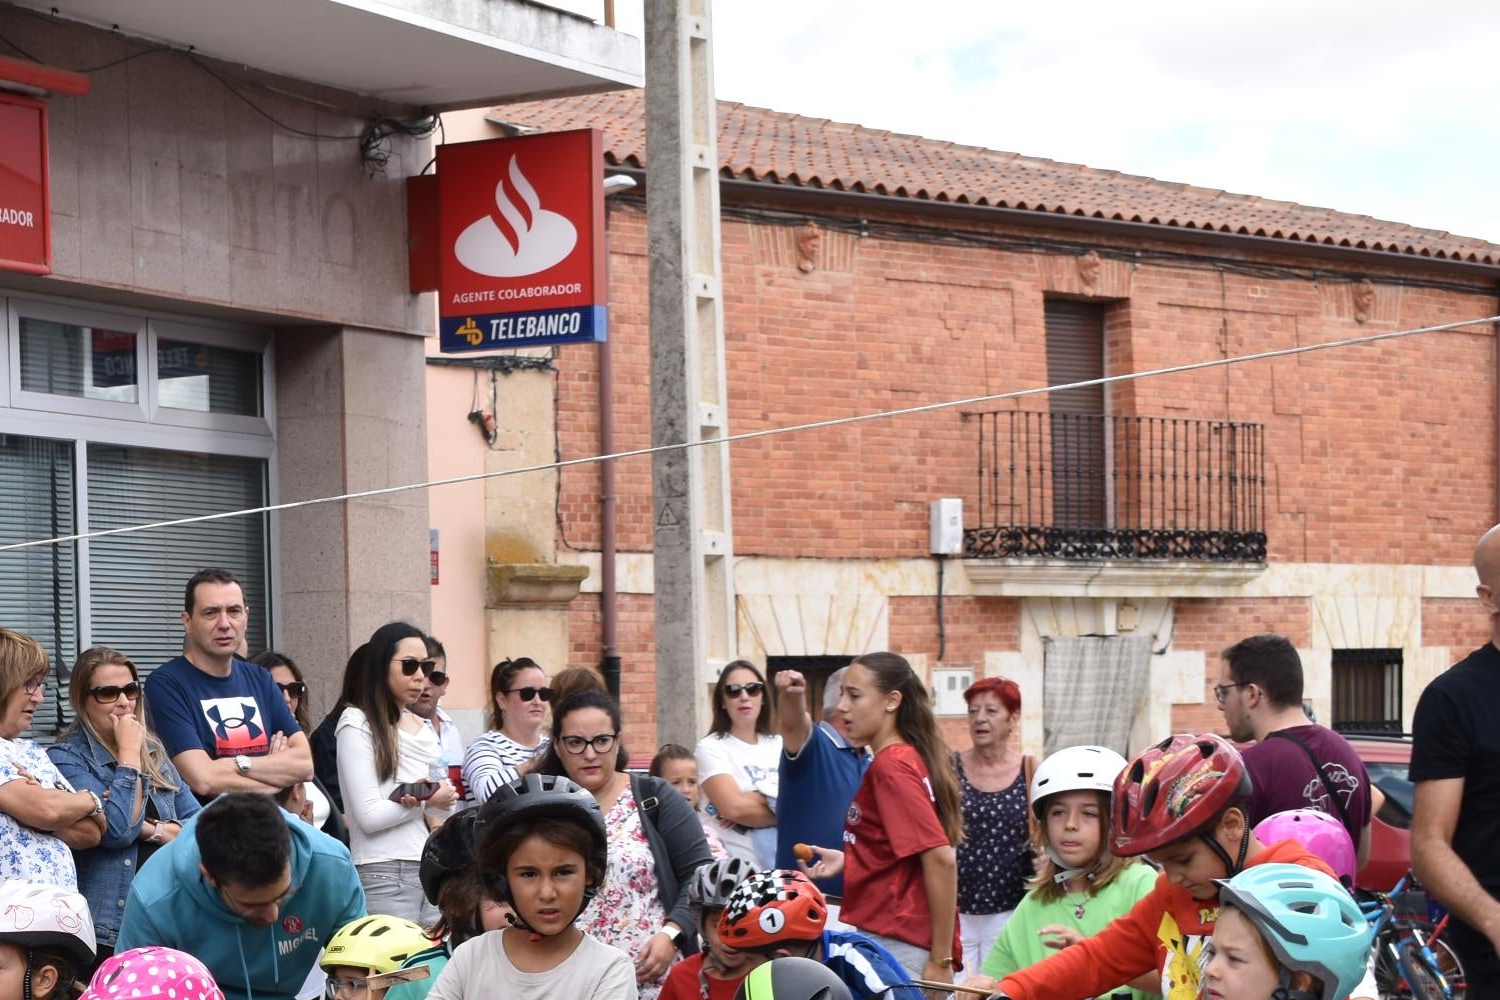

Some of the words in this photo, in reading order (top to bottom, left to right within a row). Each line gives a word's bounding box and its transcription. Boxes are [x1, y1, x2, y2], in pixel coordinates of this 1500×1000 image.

[452, 290, 496, 304] AGENTE
[498, 283, 582, 300] COLABORADOR
[490, 312, 581, 341] TELEBANCO
[765, 913, 776, 928] 1
